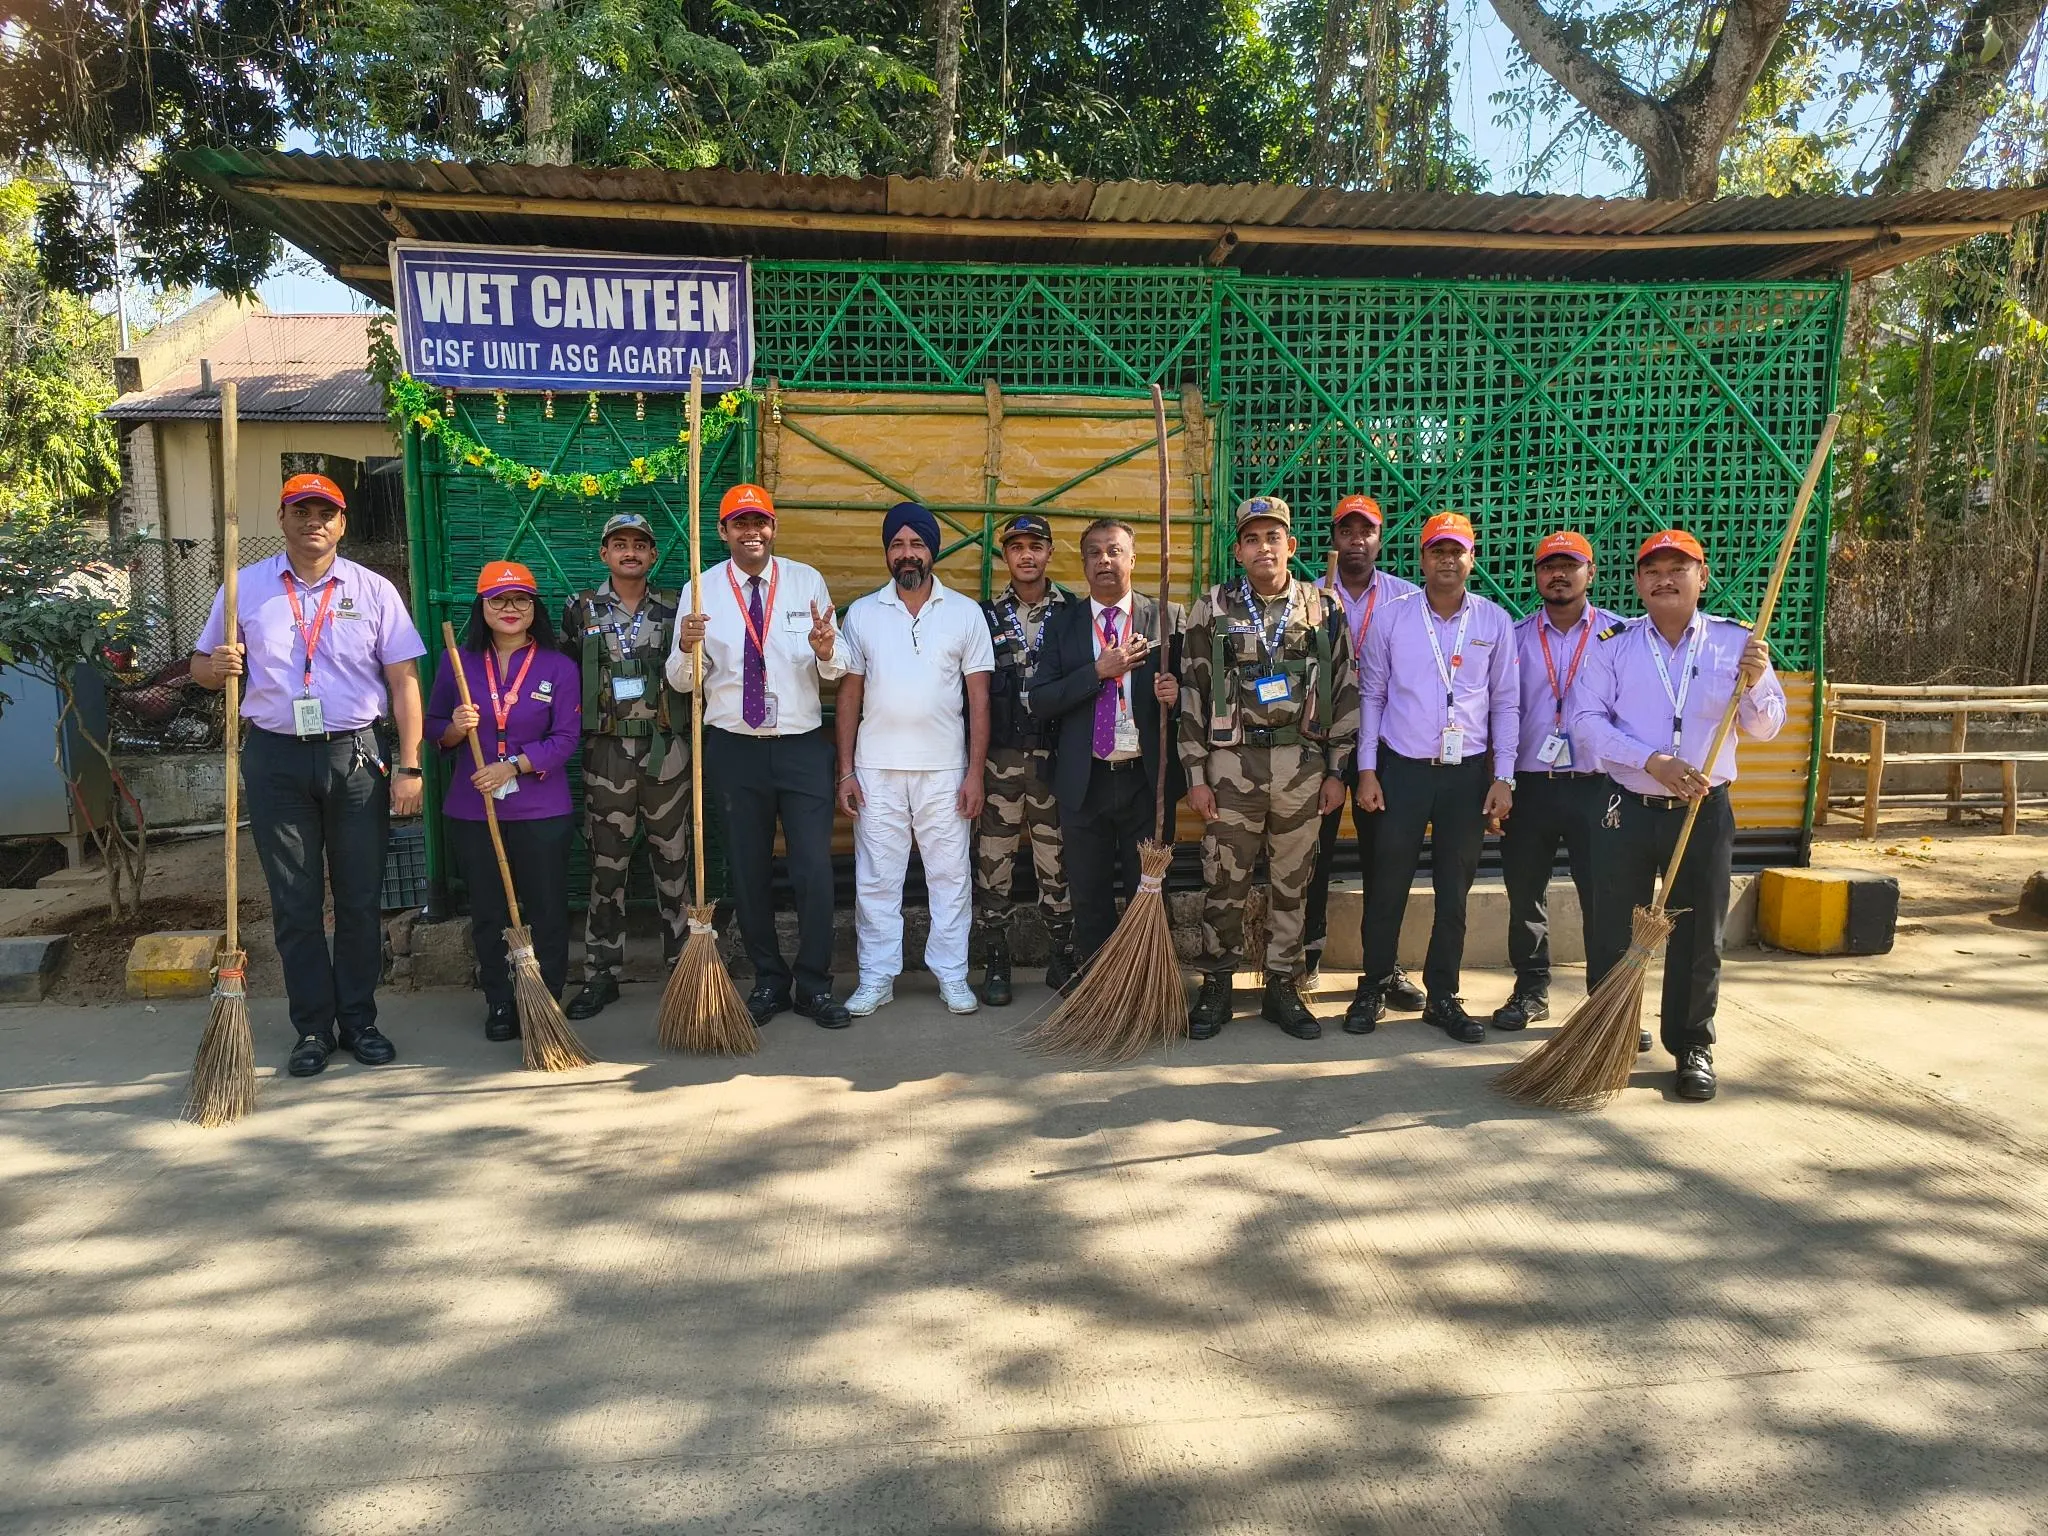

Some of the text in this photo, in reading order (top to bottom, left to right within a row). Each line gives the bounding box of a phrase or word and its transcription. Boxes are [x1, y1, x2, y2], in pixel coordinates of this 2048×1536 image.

[415, 271, 730, 332] WET CANTEEN
[420, 338, 733, 375] CISF UNIT ASG AGARTALA
